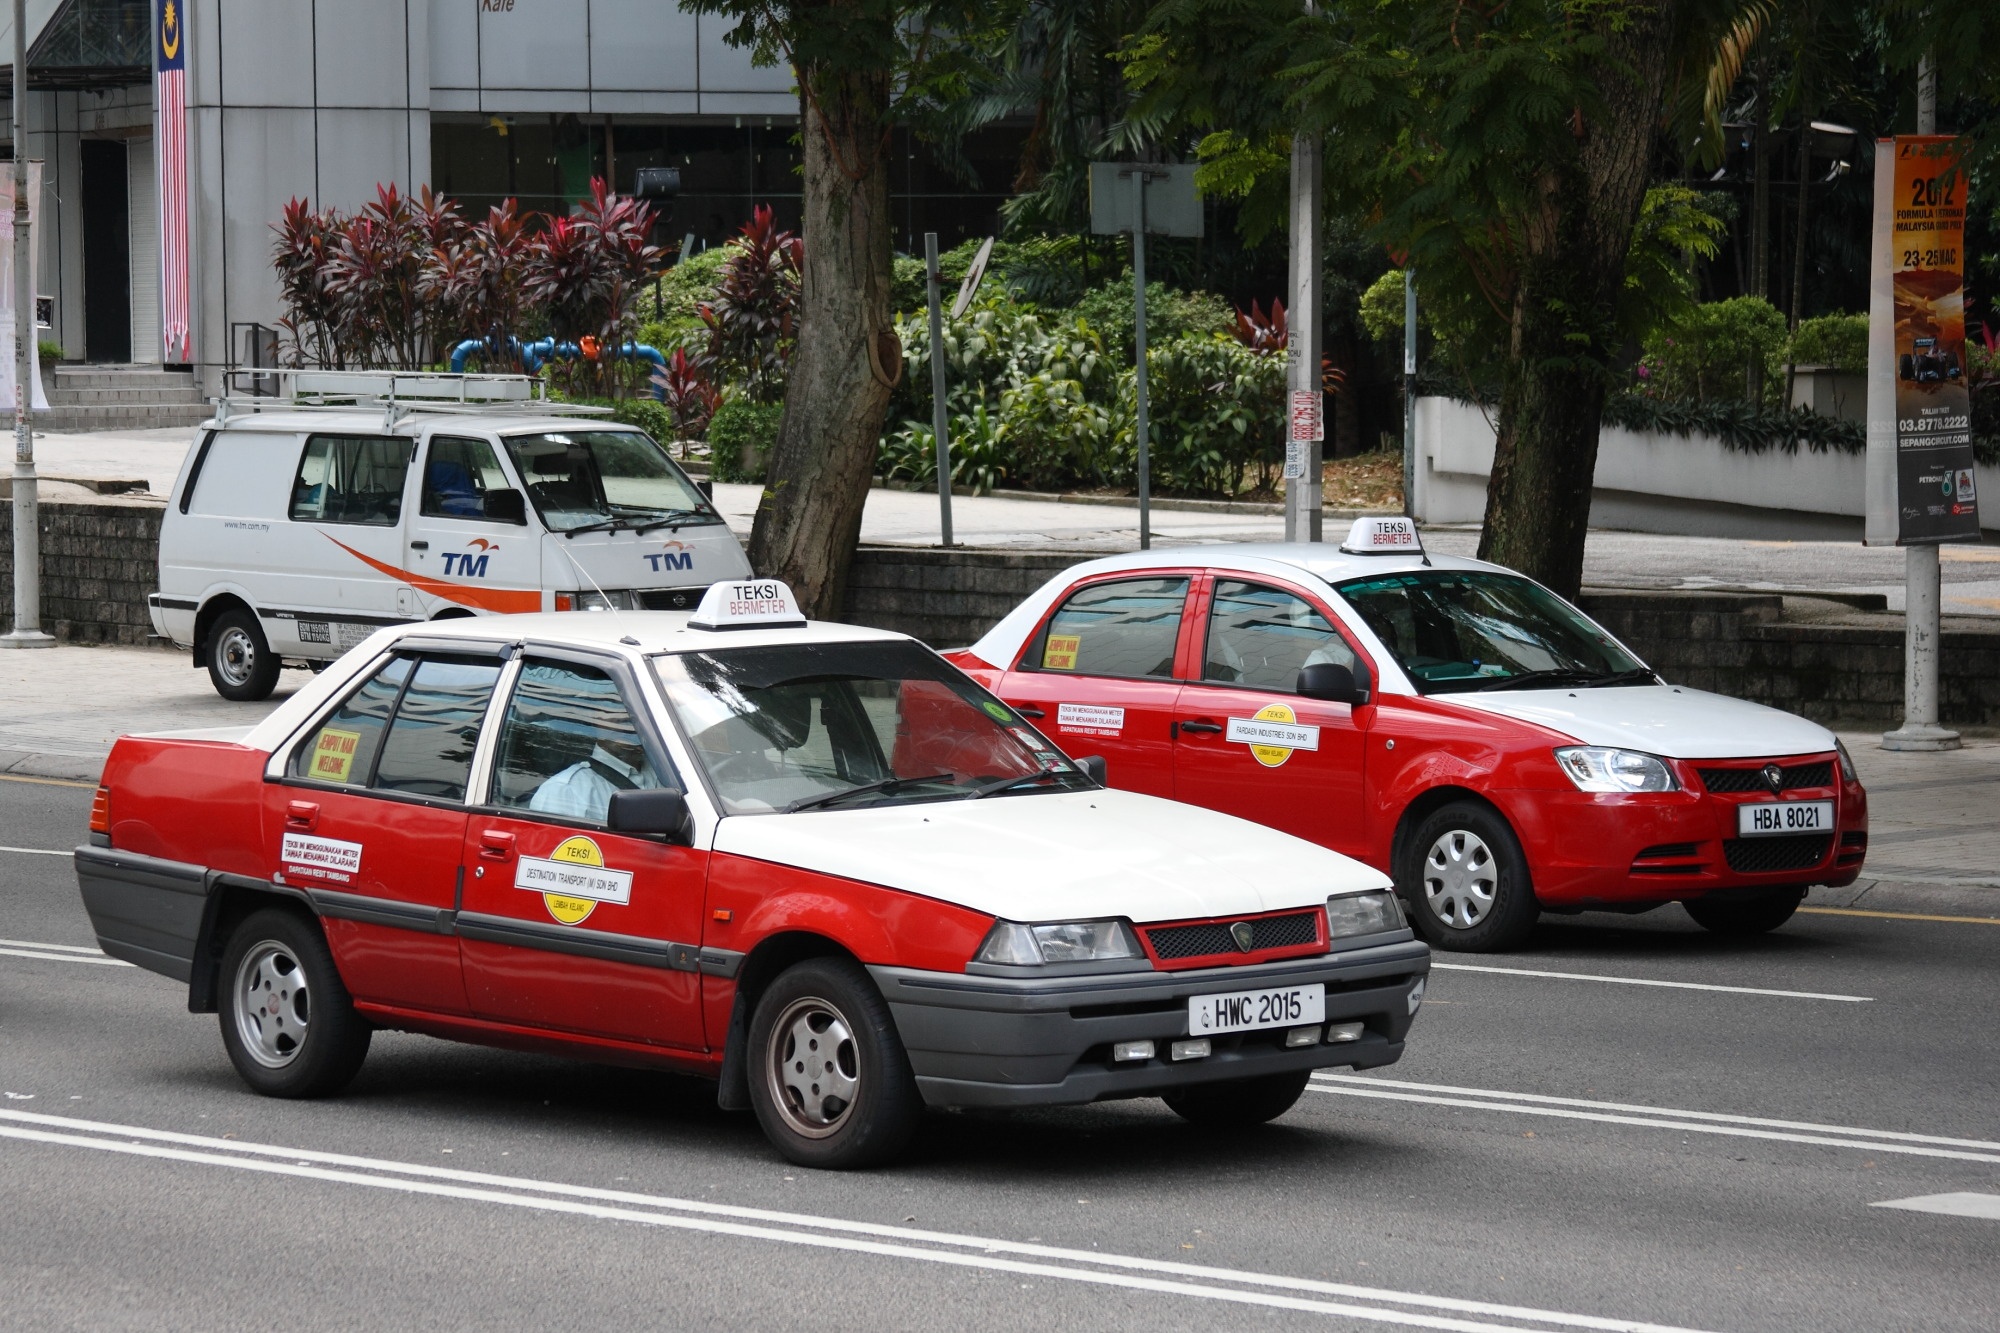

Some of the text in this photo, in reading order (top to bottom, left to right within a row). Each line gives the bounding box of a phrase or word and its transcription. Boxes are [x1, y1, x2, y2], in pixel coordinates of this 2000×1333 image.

[1896, 209, 1933, 219] FORMULA
[1896, 221, 1935, 232] MALAYSIA
[1900, 416, 1968, 432] 03.8778.2222
[1900, 434, 1969, 447] SEPANGCIRCUIT.COM
[224, 521, 270, 532] www.tm.com.my
[1376, 522, 1407, 533] TEKSI
[1373, 533, 1412, 545] BERMETER
[441, 552, 489, 577] TM
[643, 552, 693, 572] TM
[733, 585, 779, 600] TEKSI
[730, 600, 786, 615] BERMETER
[1076, 716, 1097, 724] MENAWAR
[1098, 718, 1121, 726] DILARANG
[1267, 711, 1286, 719] TEKSI
[1236, 726, 1308, 742] FARDAEN INDUSTRIES SDN BHD
[1754, 807, 1819, 830] HBA 8021
[285, 840, 298, 848] TEKSI
[306, 843, 341, 855] MENGGUNAKAN
[342, 849, 359, 858] METER
[566, 847, 590, 859] TEKSI
[285, 849, 357, 868] TAWAR MENAWAR DILARANG
[526, 868, 618, 892] DESTINATION TRANSPORT (M) SDN BHD
[553, 900, 585, 912] LEMBAH KELANG
[1216, 991, 1301, 1027] HWC 2015
